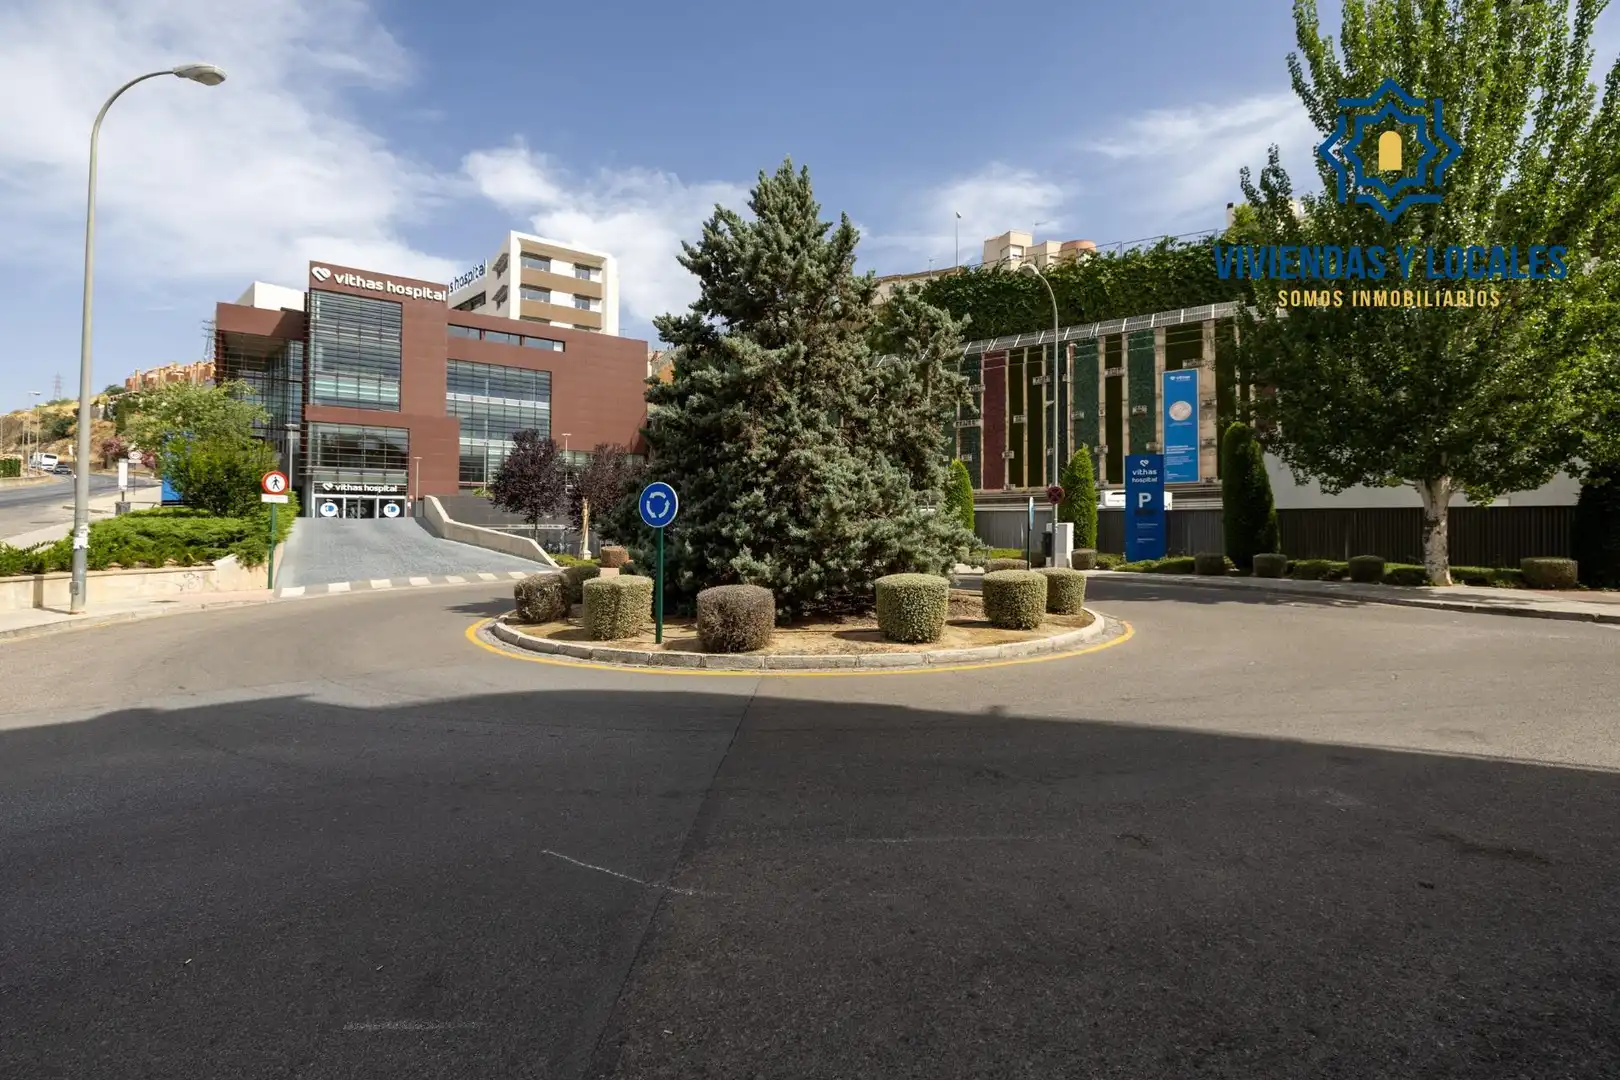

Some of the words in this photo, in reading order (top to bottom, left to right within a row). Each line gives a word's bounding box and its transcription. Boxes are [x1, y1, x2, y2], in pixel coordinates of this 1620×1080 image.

[454, 257, 487, 290] hospital
[334, 273, 384, 291] vithas
[386, 280, 447, 302] hospital
[1132, 468, 1157, 476] vithas
[1131, 476, 1158, 484] hospital
[335, 483, 363, 492] vithas
[363, 484, 398, 493] hospital
[1138, 492, 1152, 508] P
